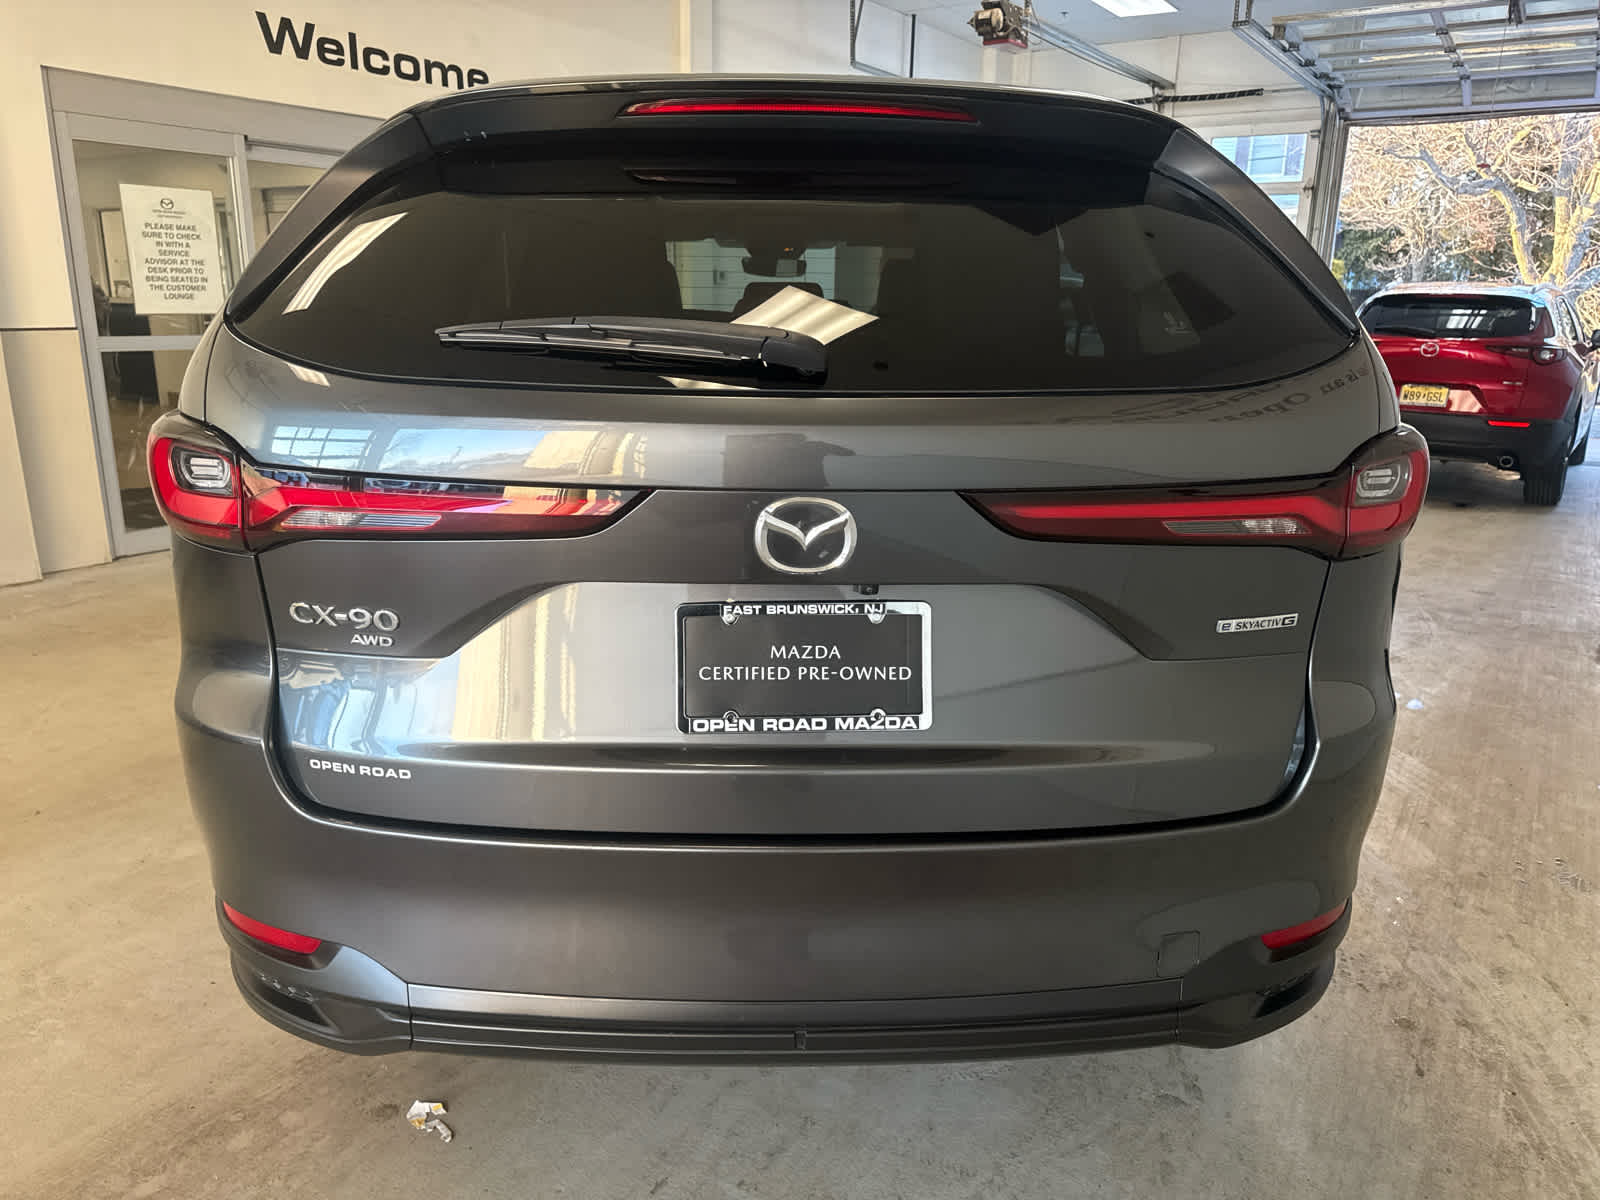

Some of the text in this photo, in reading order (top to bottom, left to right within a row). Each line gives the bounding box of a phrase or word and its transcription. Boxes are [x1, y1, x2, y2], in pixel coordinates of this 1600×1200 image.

[255, 10, 489, 90] Welcome
[144, 222, 197, 231] PLEASE MAKE
[141, 231, 202, 240] SURE TO CHECK
[166, 241, 184, 249] WITH
[158, 249, 190, 257] SERVICE
[144, 258, 205, 267] ADVISOR AT THE
[147, 266, 204, 275] DESK PRIOR TO
[145, 275, 208, 284] BEING SEATED IN
[150, 284, 207, 292] THE CUSTOMER
[164, 292, 195, 300] LOUNGE
[766, 604, 859, 615] BRUNSWICK,
[864, 603, 885, 615] NJ
[289, 602, 400, 632] CX-90
[350, 634, 394, 648] AWD
[770, 645, 841, 660] MAZDA
[698, 666, 913, 681] CERTIFIED PRE-OWNED
[692, 715, 919, 733] OPEN ROAD MAZDA
[309, 758, 412, 780] OPEN ROAD
